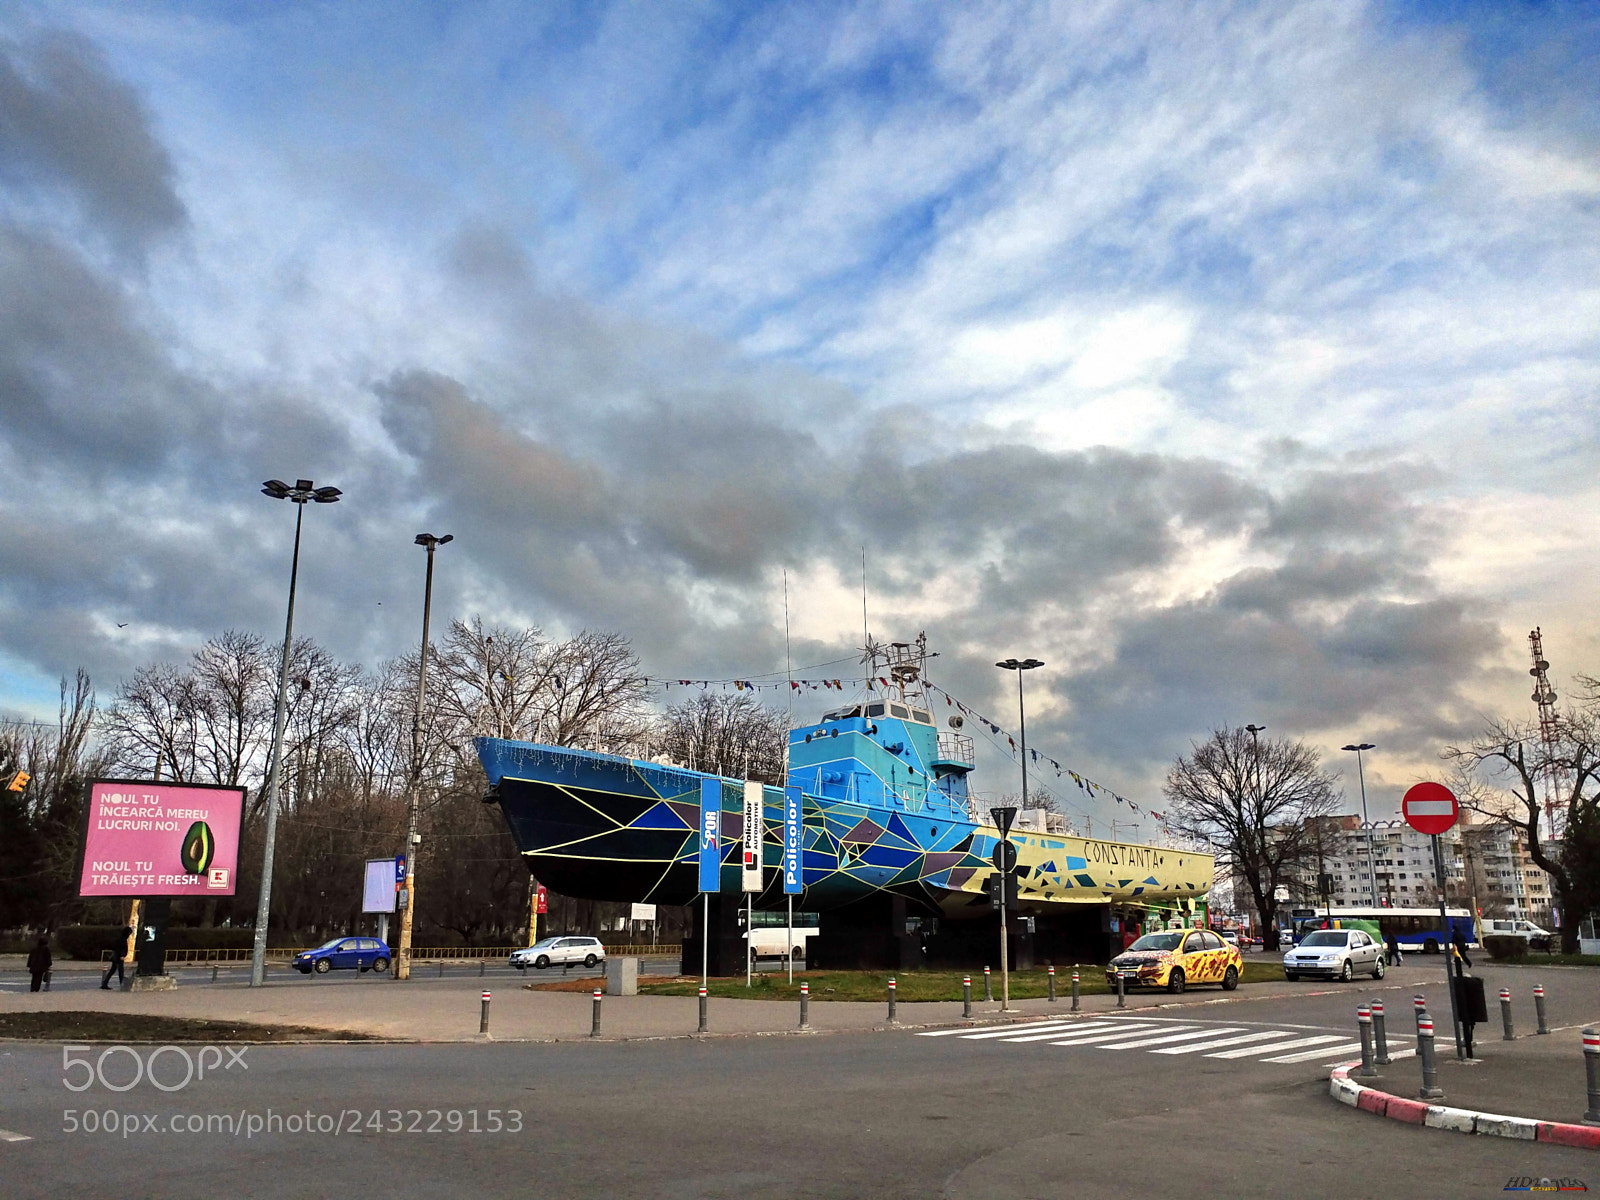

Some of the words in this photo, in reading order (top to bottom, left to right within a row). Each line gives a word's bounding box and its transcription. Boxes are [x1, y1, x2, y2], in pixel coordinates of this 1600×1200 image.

[101, 793, 137, 804] NOUL
[142, 795, 159, 804] TU
[99, 804, 163, 818] ÎNCEARCĂ
[166, 808, 208, 819] MEREU
[98, 820, 152, 830] LUCRURI
[155, 821, 181, 831] NOI.
[702, 810, 717, 852] SPOR
[745, 801, 753, 849] Policolor
[787, 799, 797, 885] Policolor
[92, 861, 131, 872] NOUL
[135, 862, 153, 872] TU
[157, 875, 201, 885] FRESH.
